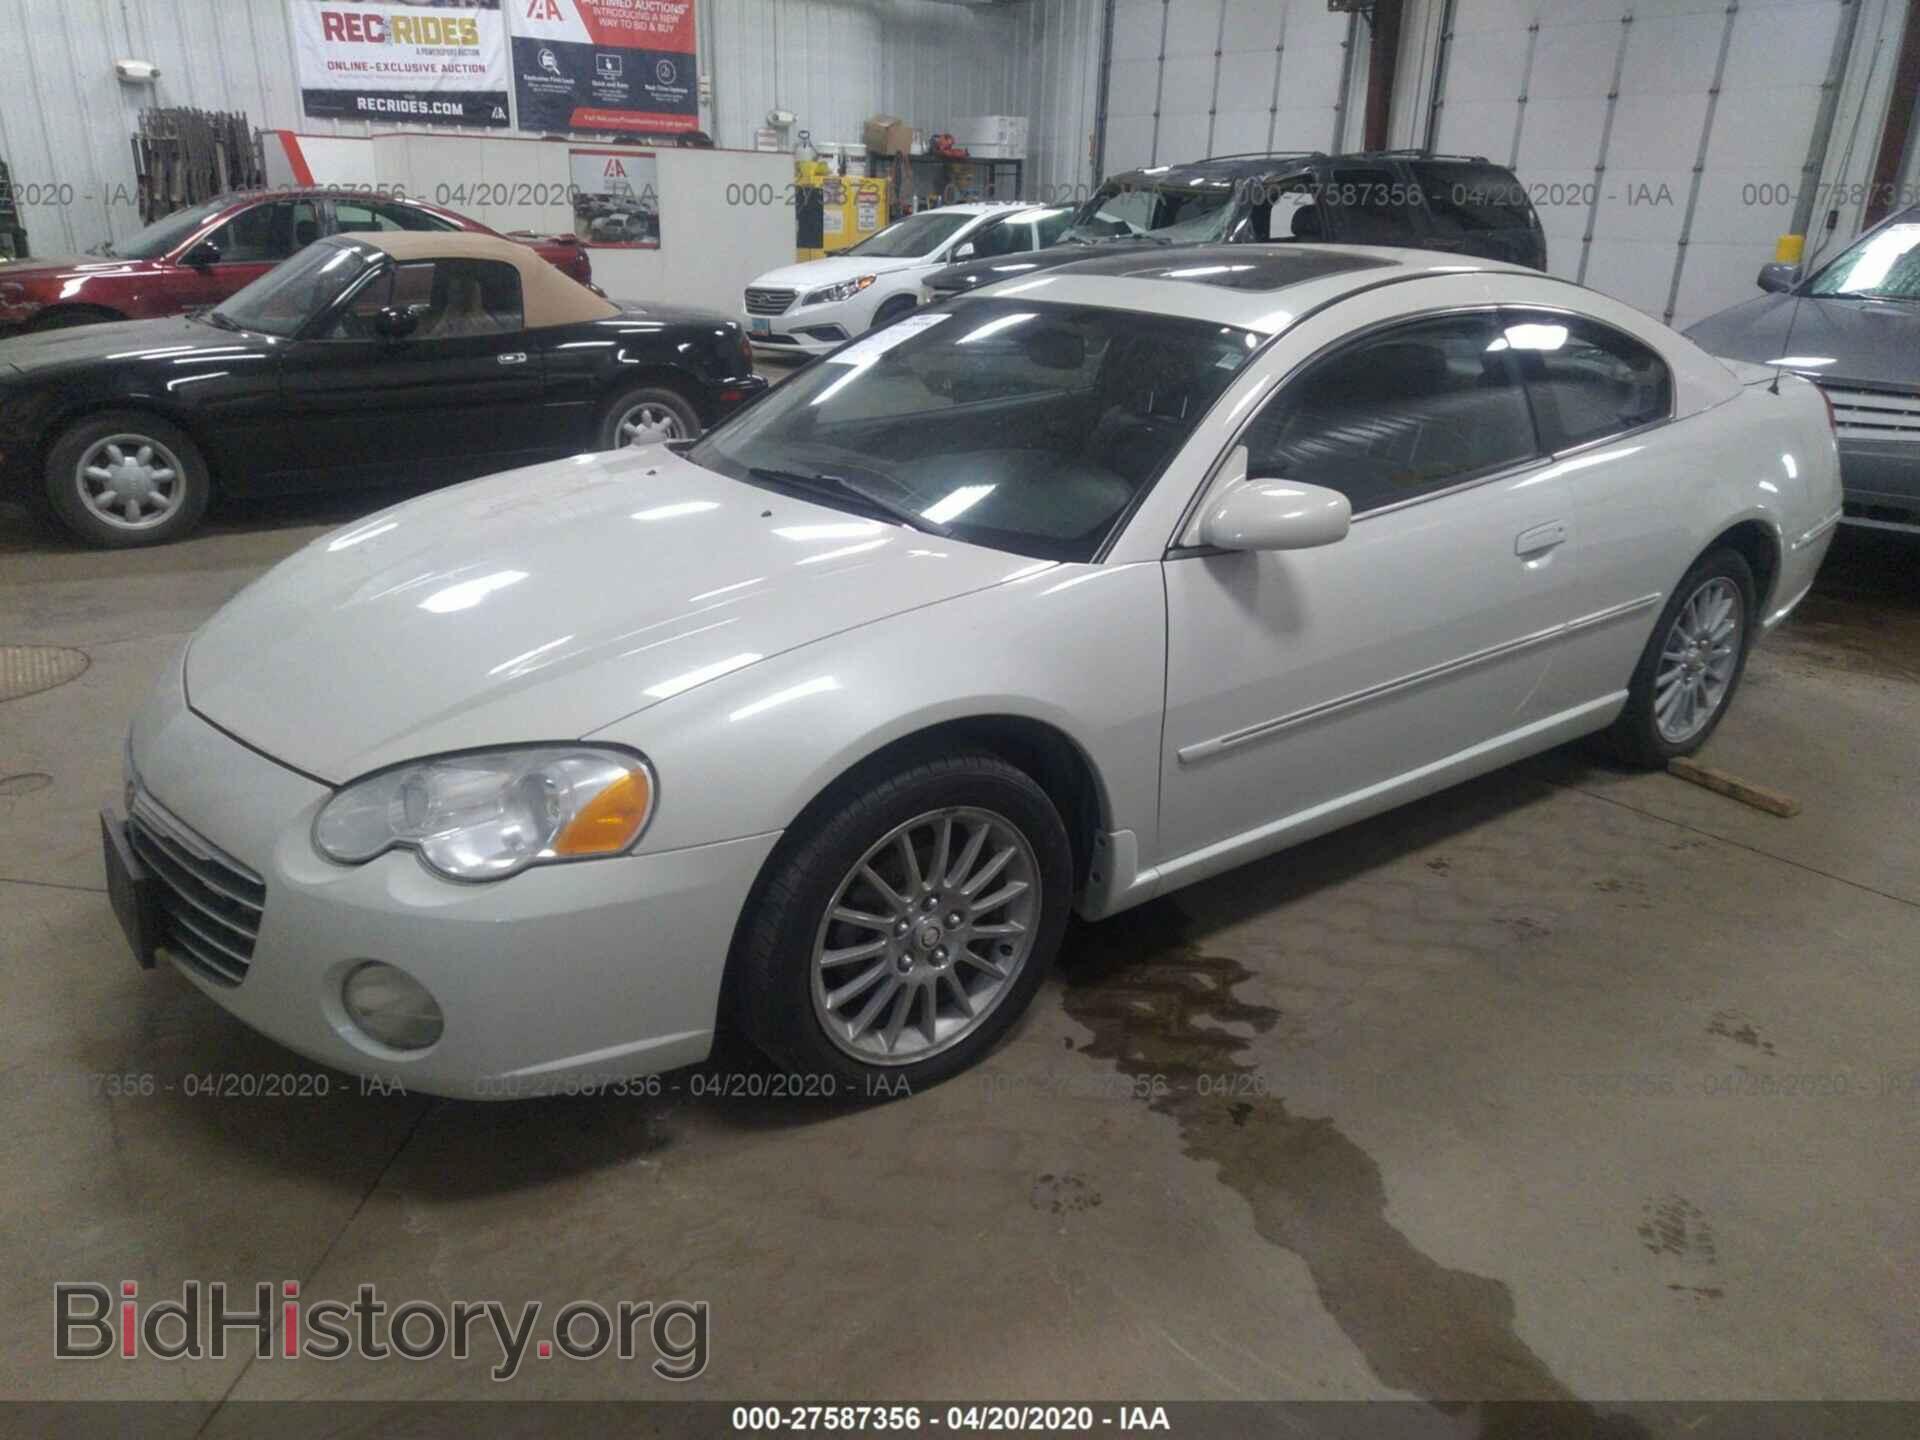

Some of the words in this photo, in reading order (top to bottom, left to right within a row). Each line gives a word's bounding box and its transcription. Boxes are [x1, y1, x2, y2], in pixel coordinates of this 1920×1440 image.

[320, 11, 386, 43] REC
[391, 15, 480, 46] RIDES
[599, 17, 619, 28] WAY
[656, 23, 675, 33] BUY
[327, 60, 437, 74] ONLINE-EXCLUSIVE
[441, 63, 486, 74] AUCTION
[356, 97, 464, 117] RECRIDES.COM
